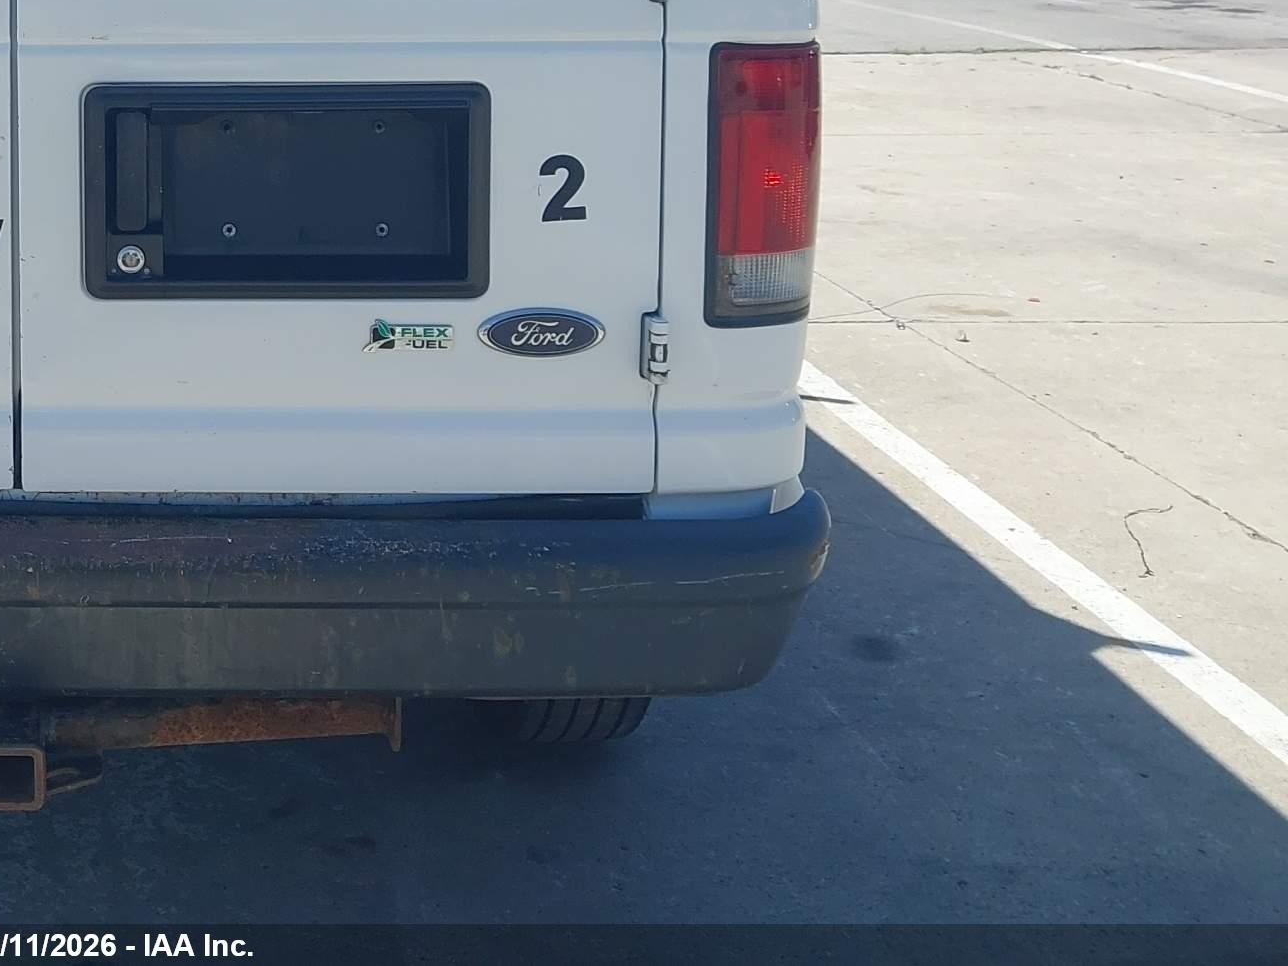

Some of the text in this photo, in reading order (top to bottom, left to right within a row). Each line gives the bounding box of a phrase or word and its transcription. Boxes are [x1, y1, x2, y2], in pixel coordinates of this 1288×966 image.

[538, 154, 588, 223] 2
[401, 328, 449, 338] FLEX
[511, 320, 575, 346] Ford
